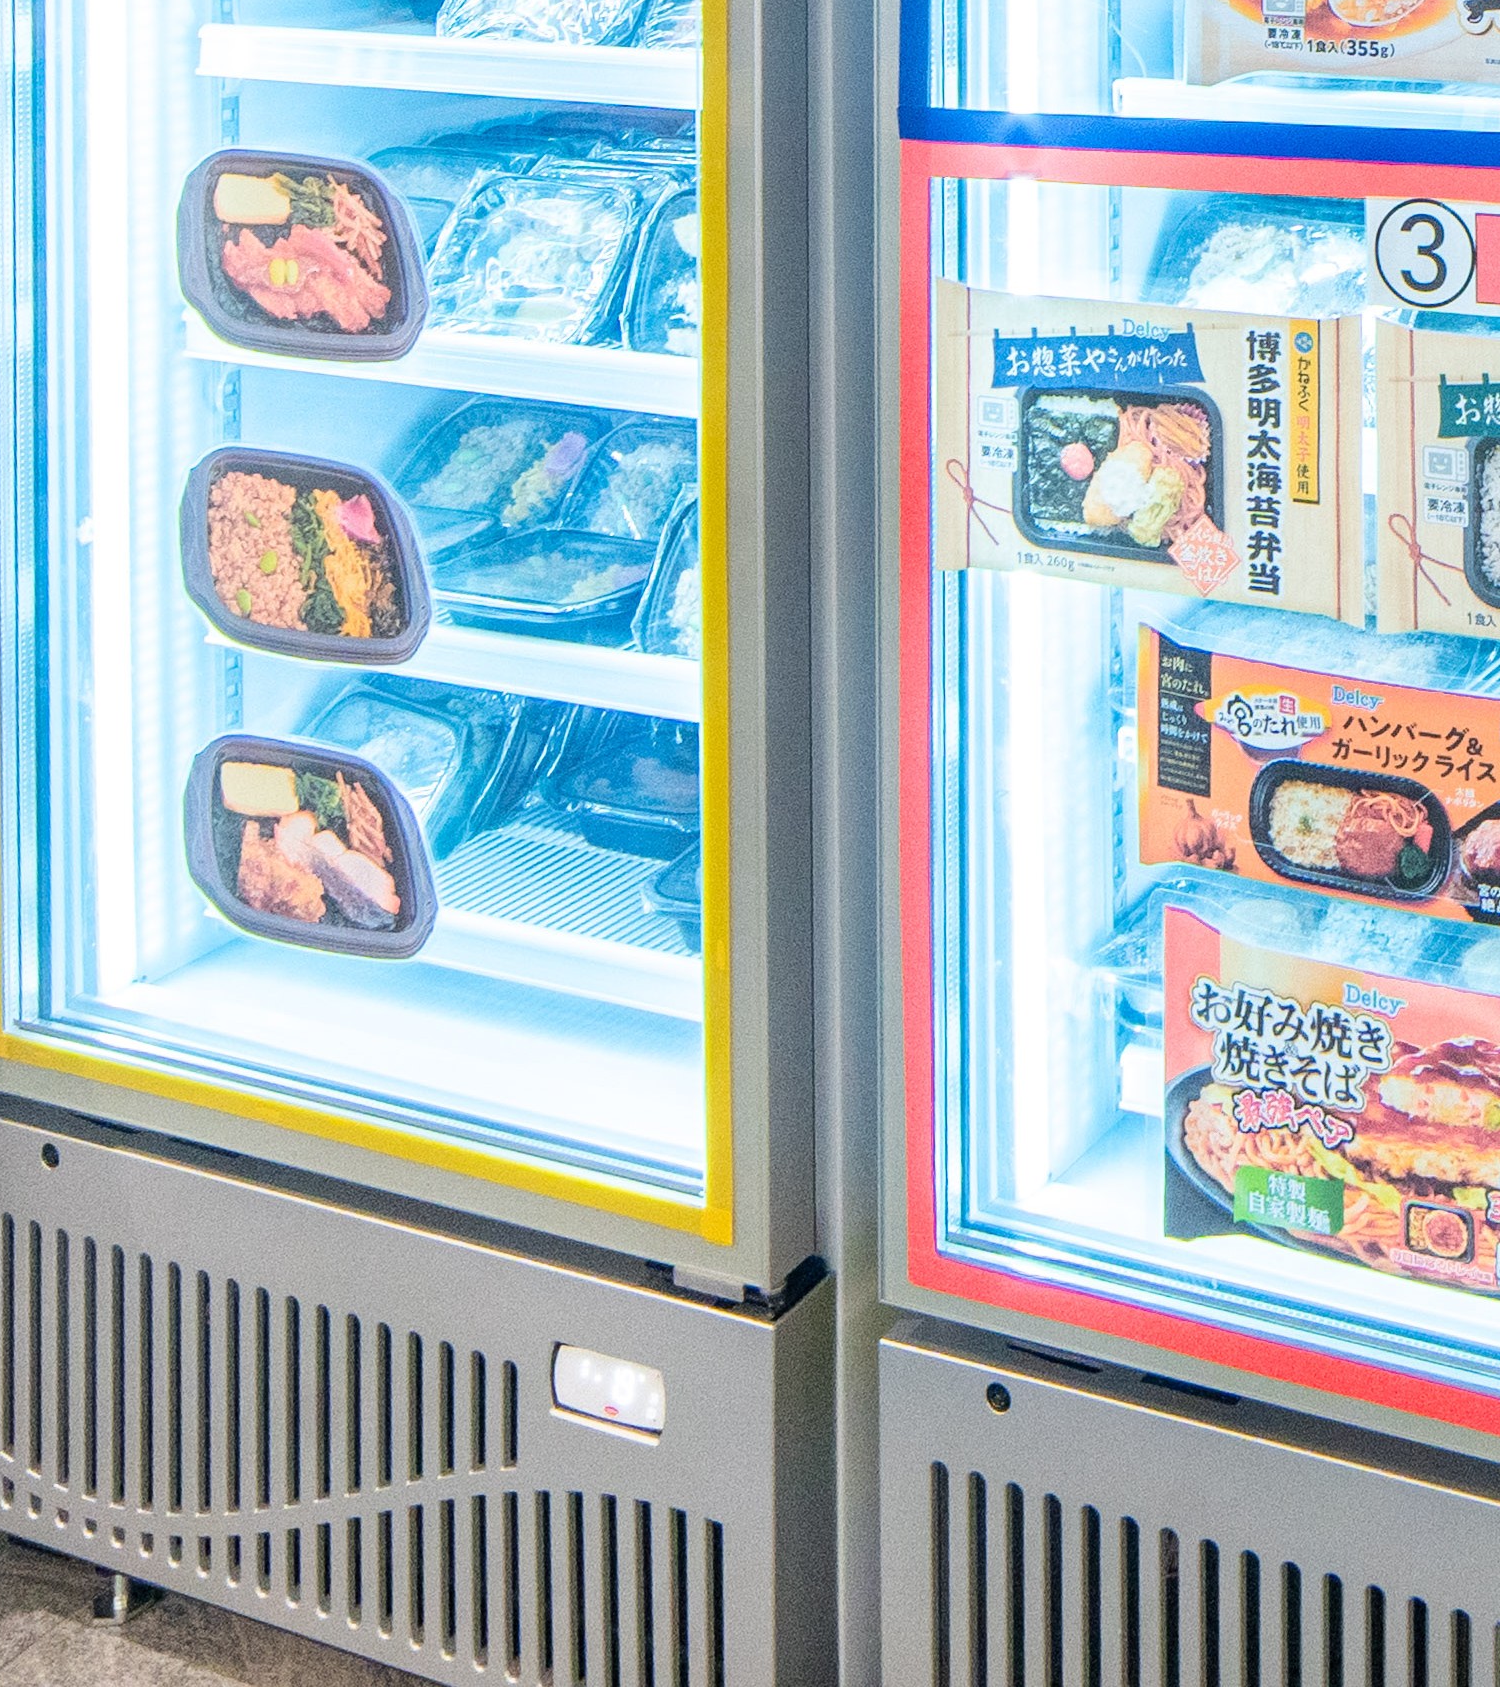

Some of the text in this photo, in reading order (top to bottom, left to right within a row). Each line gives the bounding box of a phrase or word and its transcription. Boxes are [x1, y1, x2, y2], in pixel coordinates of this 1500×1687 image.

[1122, 319, 1171, 342] Delcy
[1005, 346, 1188, 377] お惣菜やさんが作った
[1246, 330, 1283, 596] 博多明太海苔弁当
[1427, 499, 1466, 514] 要冷凍
[1047, 555, 1076, 572] 260g
[1467, 613, 1497, 629] 1食入
[1332, 685, 1383, 710] Delcy
[1343, 715, 1483, 757] ハンバーグ&
[1331, 737, 1498, 784] ガーリックライス
[1345, 983, 1406, 1016] Delcy
[1196, 981, 1389, 1065] お好み焼き
[1220, 1032, 1360, 1104] 焼きそば
